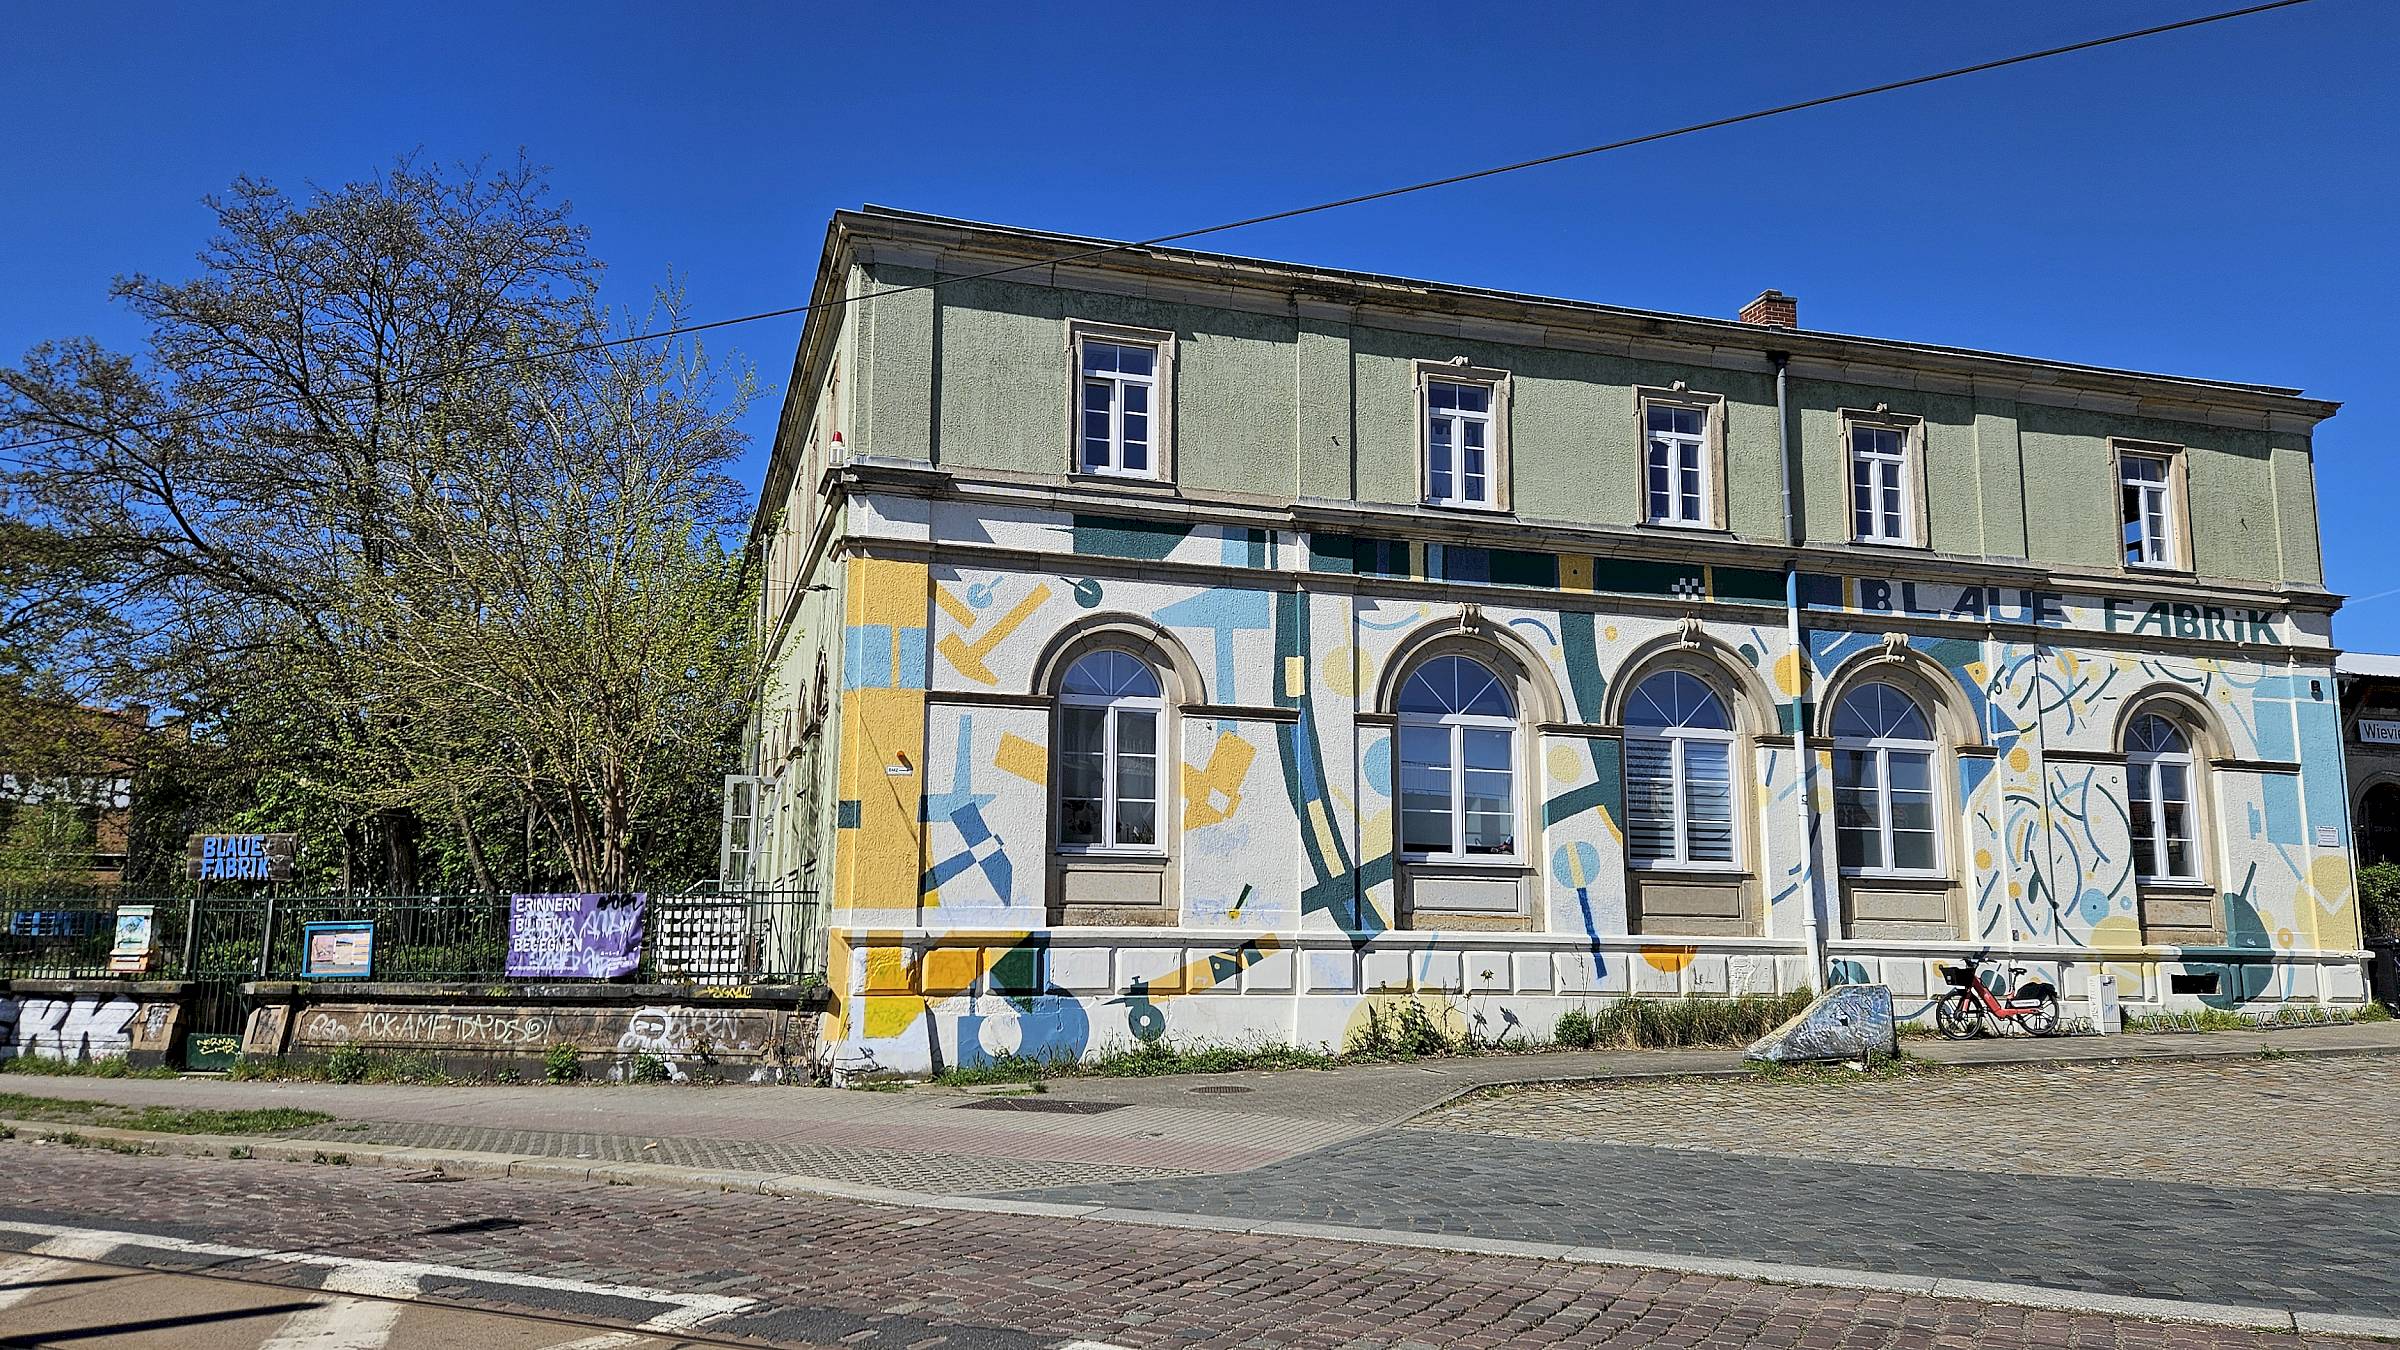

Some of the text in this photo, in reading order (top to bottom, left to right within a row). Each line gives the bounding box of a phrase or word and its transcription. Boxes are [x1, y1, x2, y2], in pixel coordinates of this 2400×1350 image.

[1860, 578, 2064, 628] BLAUE
[203, 835, 265, 858] BLAUE
[201, 856, 269, 880] FABRIK
[516, 898, 581, 912] ERINNERN
[515, 918, 562, 933] BILDEN
[513, 938, 582, 952] BEGEGNEN
